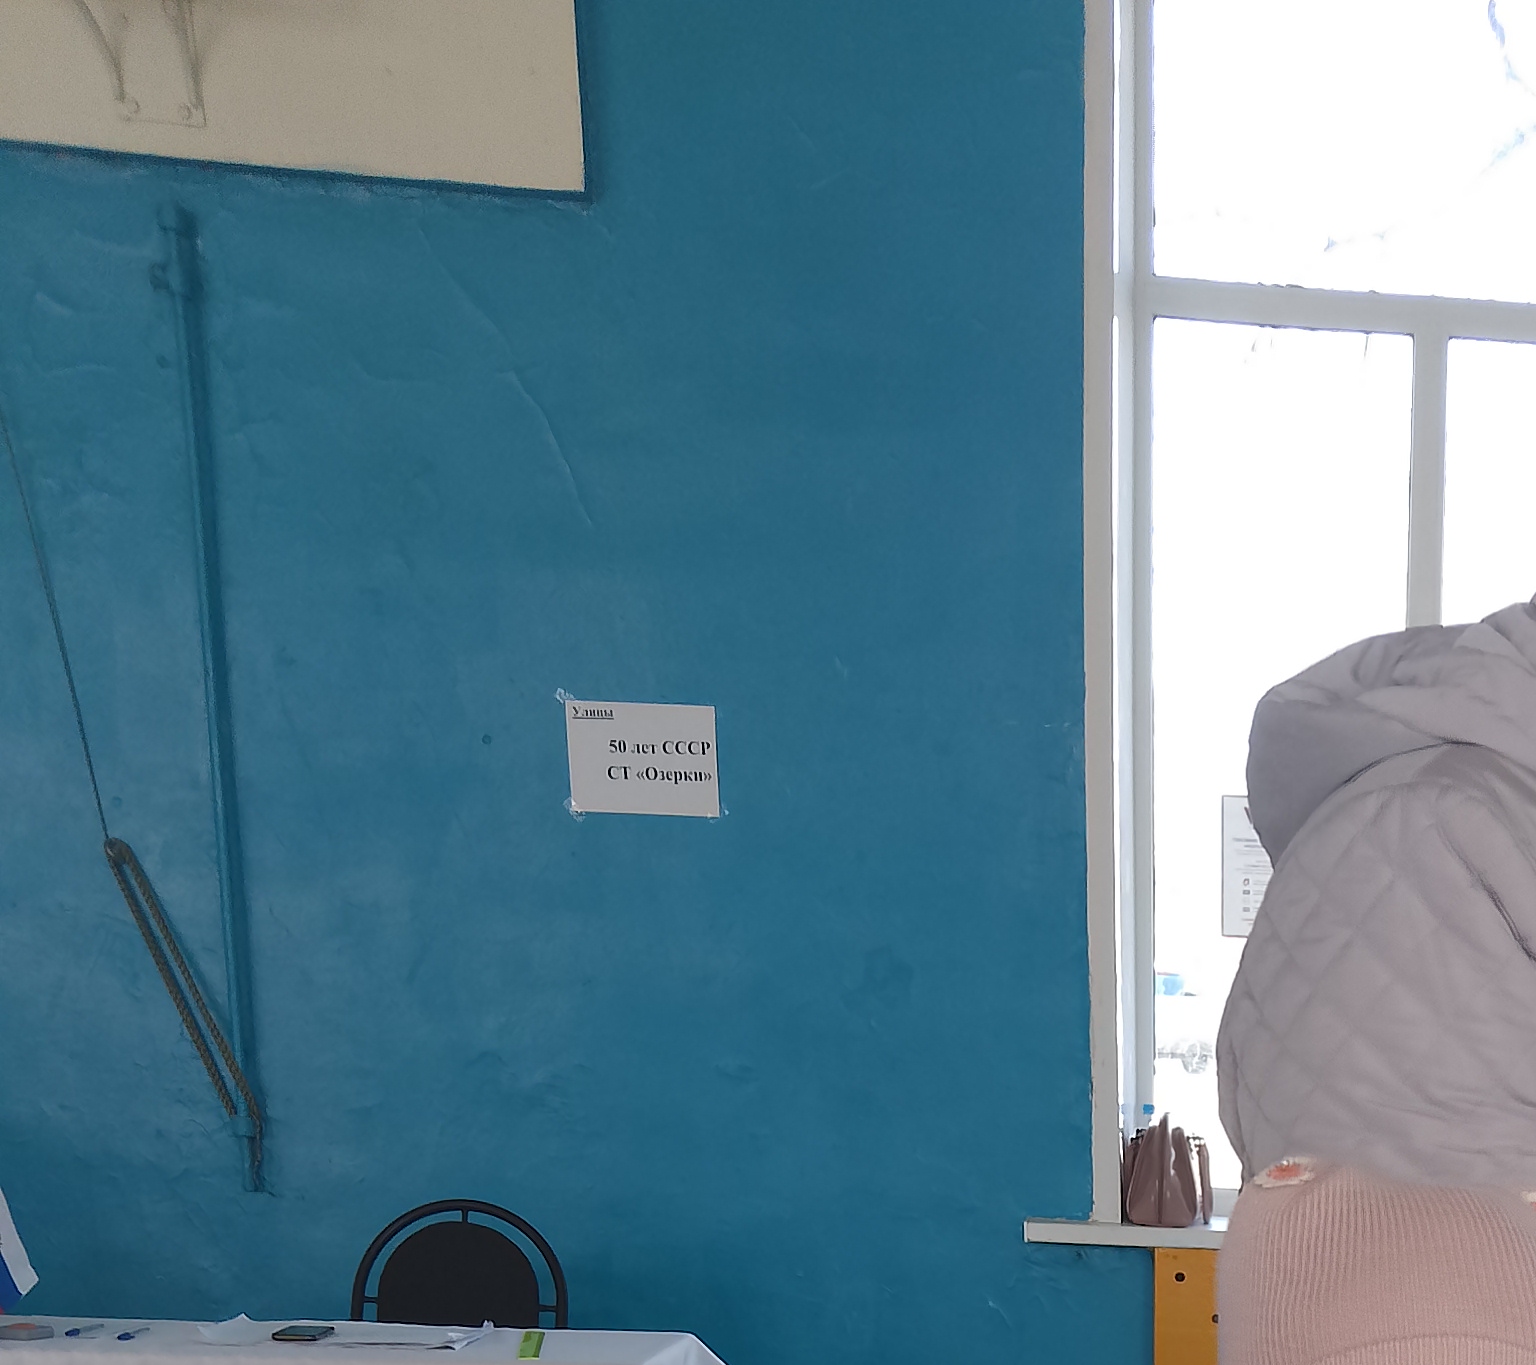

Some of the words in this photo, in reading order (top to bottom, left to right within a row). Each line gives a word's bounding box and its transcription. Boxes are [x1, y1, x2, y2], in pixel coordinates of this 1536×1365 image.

[608, 739, 627, 754] 50
[631, 743, 658, 755] лет
[662, 740, 712, 756] СССР
[607, 766, 631, 781] СТ
[636, 766, 713, 785] «Озерки»
